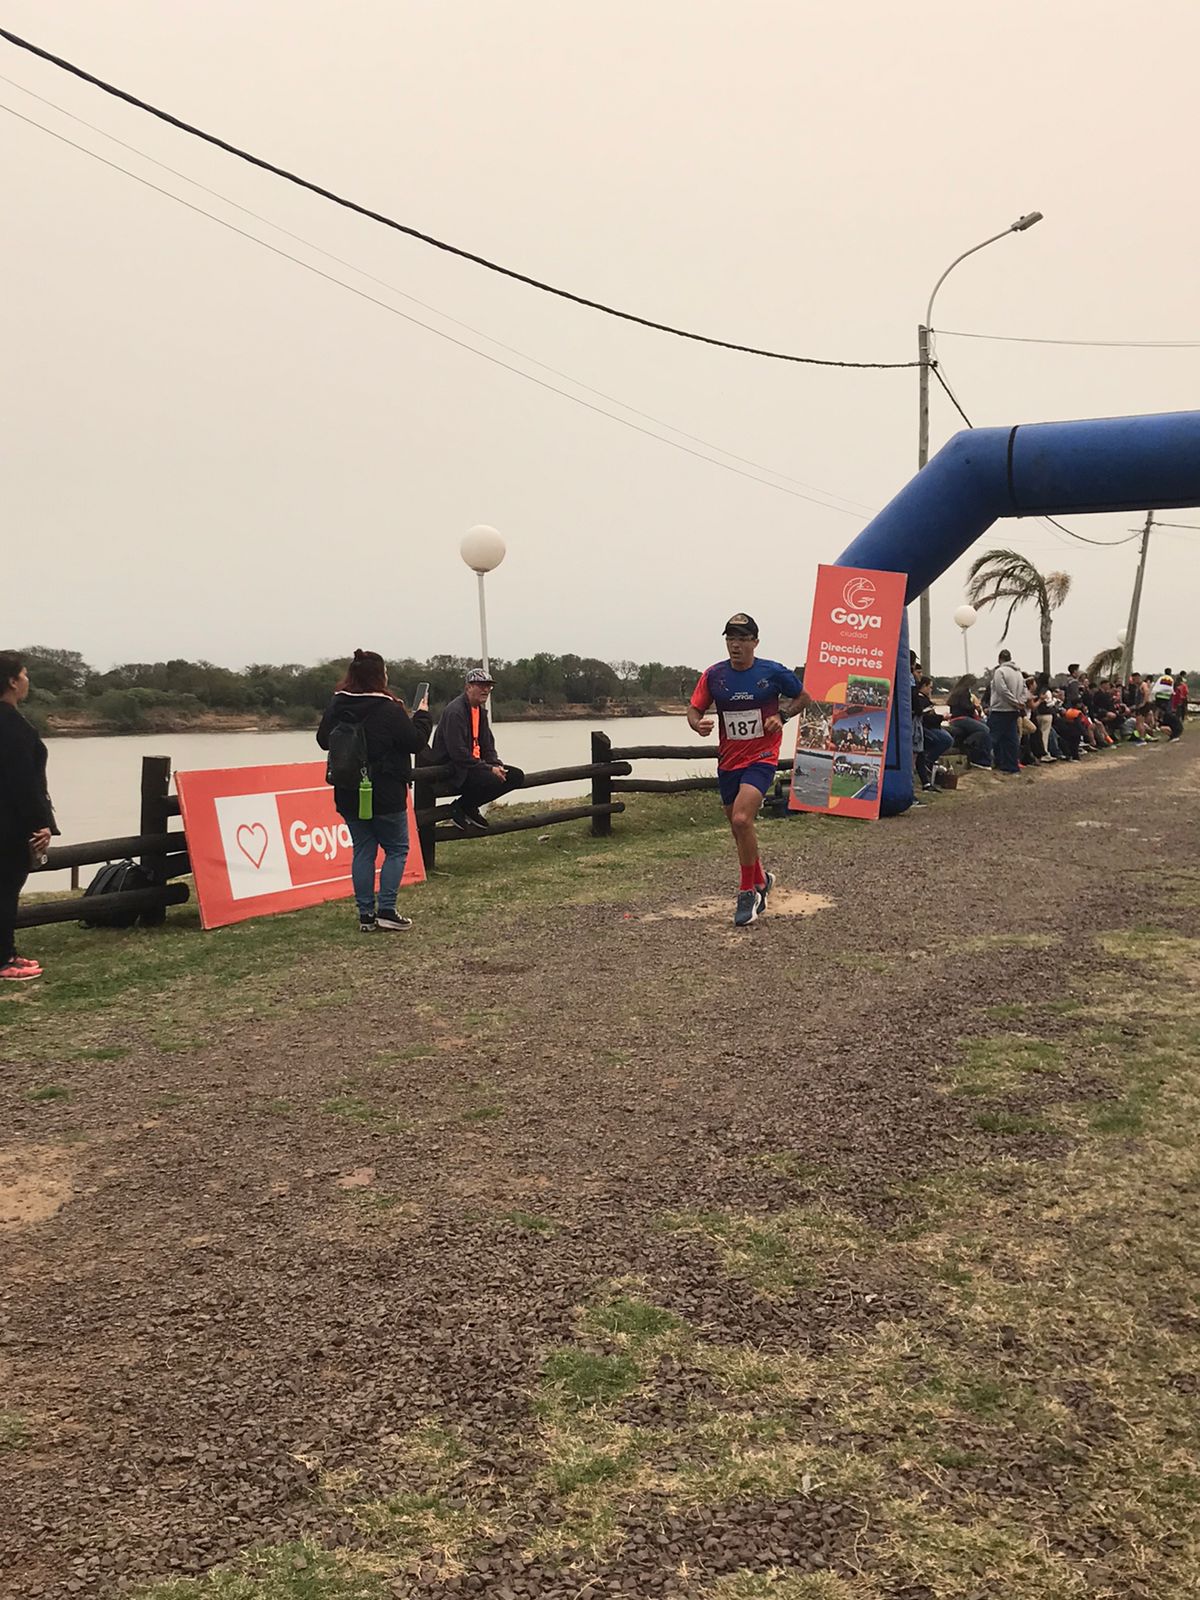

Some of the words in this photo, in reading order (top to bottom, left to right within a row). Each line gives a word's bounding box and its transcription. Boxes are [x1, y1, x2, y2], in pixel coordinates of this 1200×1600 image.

[831, 607, 882, 630] Goya
[840, 630, 868, 639] ciudad
[820, 641, 868, 655] Dirección
[870, 647, 884, 657] de
[819, 651, 883, 669] Deportes
[728, 719, 758, 736] 187
[289, 819, 354, 860] Goya
